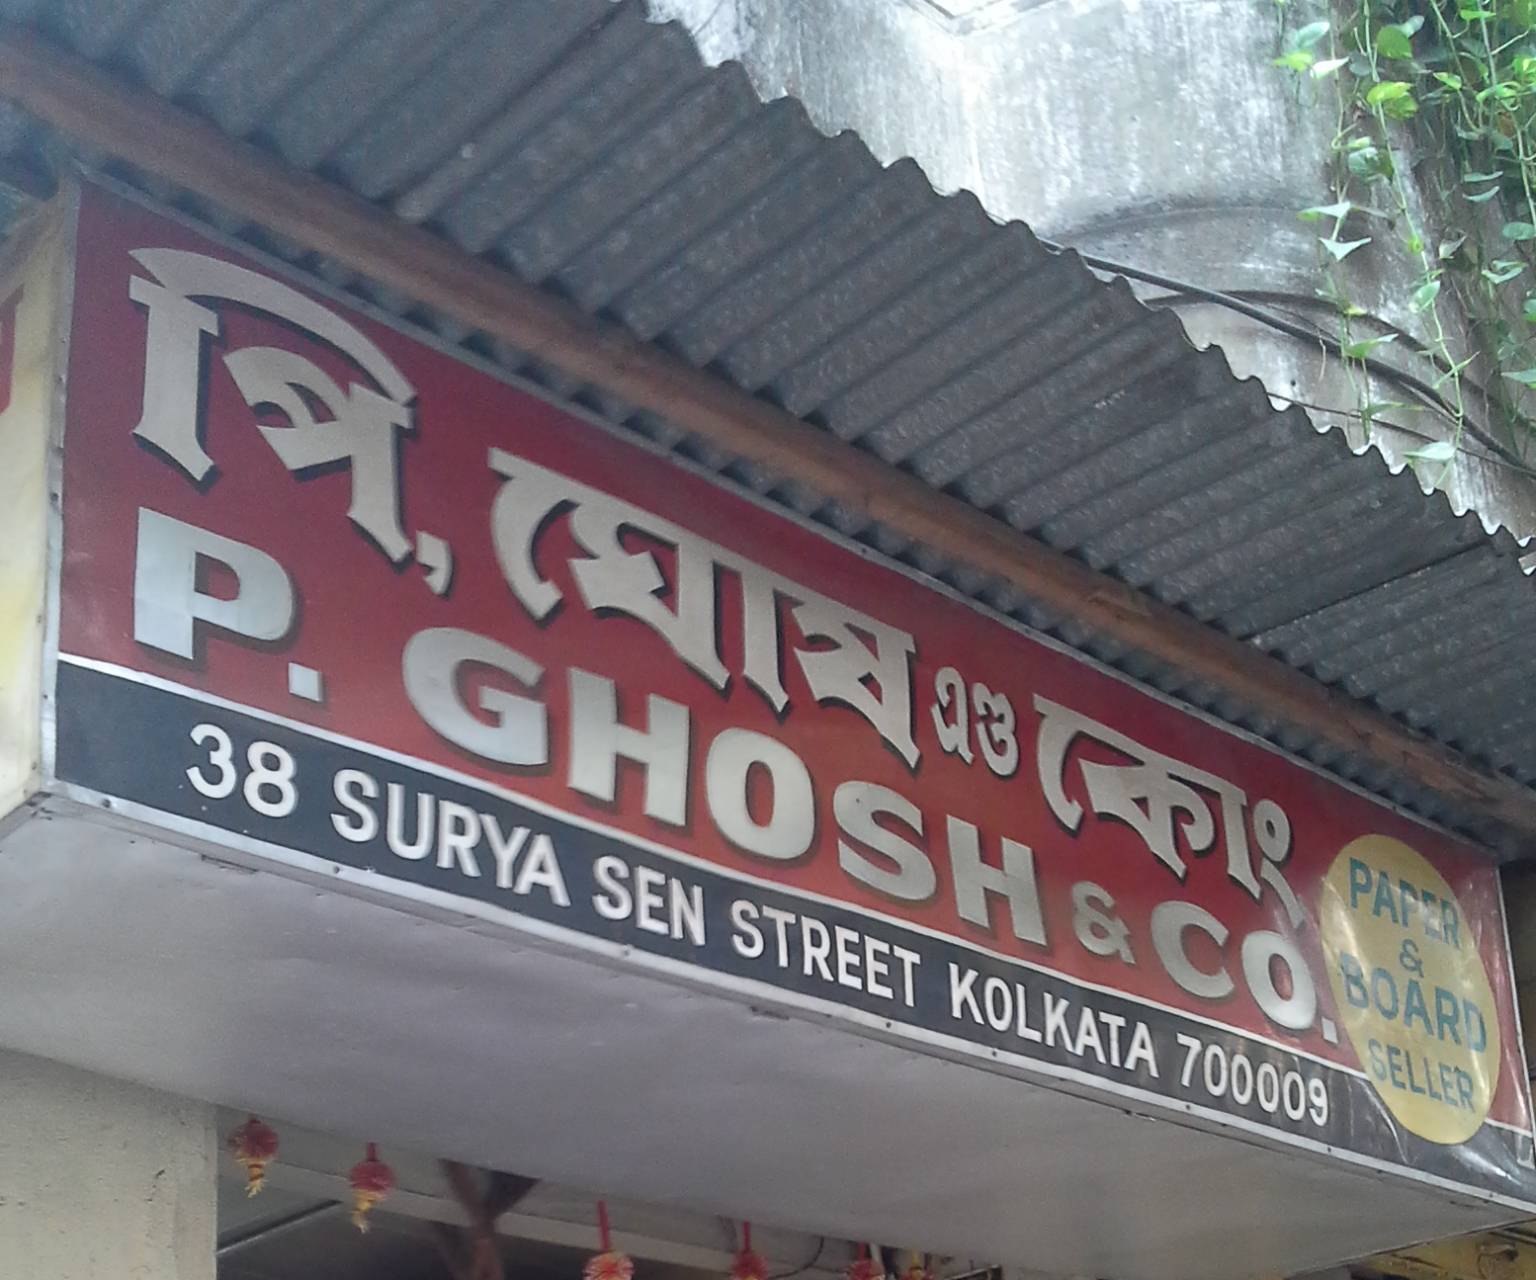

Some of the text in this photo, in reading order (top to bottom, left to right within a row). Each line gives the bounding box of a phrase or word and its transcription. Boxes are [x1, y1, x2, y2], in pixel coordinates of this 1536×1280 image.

[488, 447, 920, 768] ঘোষ
[1033, 694, 1303, 928] কোং
[134, 506, 1339, 1044] P. GHOSH & CO.
[186, 724, 1329, 1126] 38 SURYA SEN STREET KOLKATA 700009
[1350, 857, 1461, 951] PAPER
[1338, 951, 1487, 1054] BOARD
[1400, 939, 1424, 978] &
[1368, 1038, 1476, 1112] SELLER
